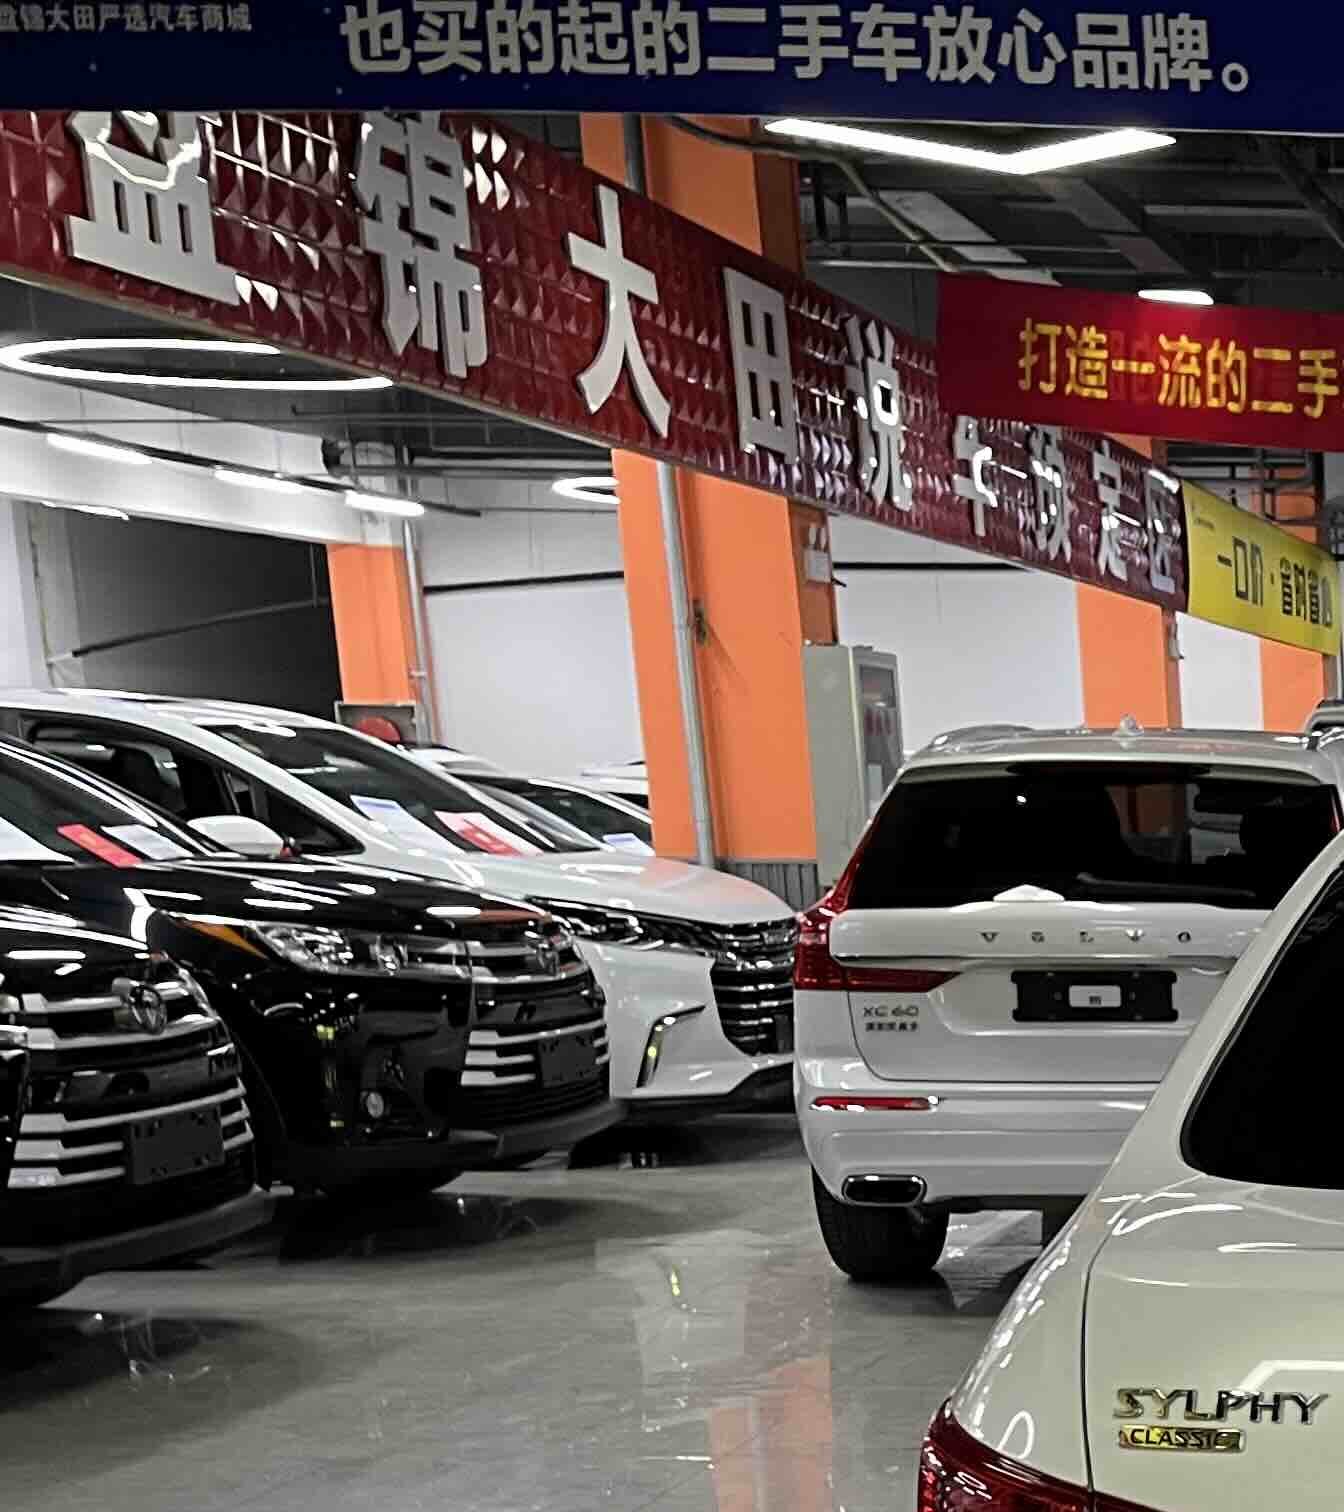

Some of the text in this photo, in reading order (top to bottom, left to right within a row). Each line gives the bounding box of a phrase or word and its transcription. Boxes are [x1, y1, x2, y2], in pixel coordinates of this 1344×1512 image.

[340, 2, 1249, 93] 也买的起的二手车放心品牌。
[979, 929, 1193, 944] VOLVO
[1113, 1387, 1331, 1425] SYLPHY
